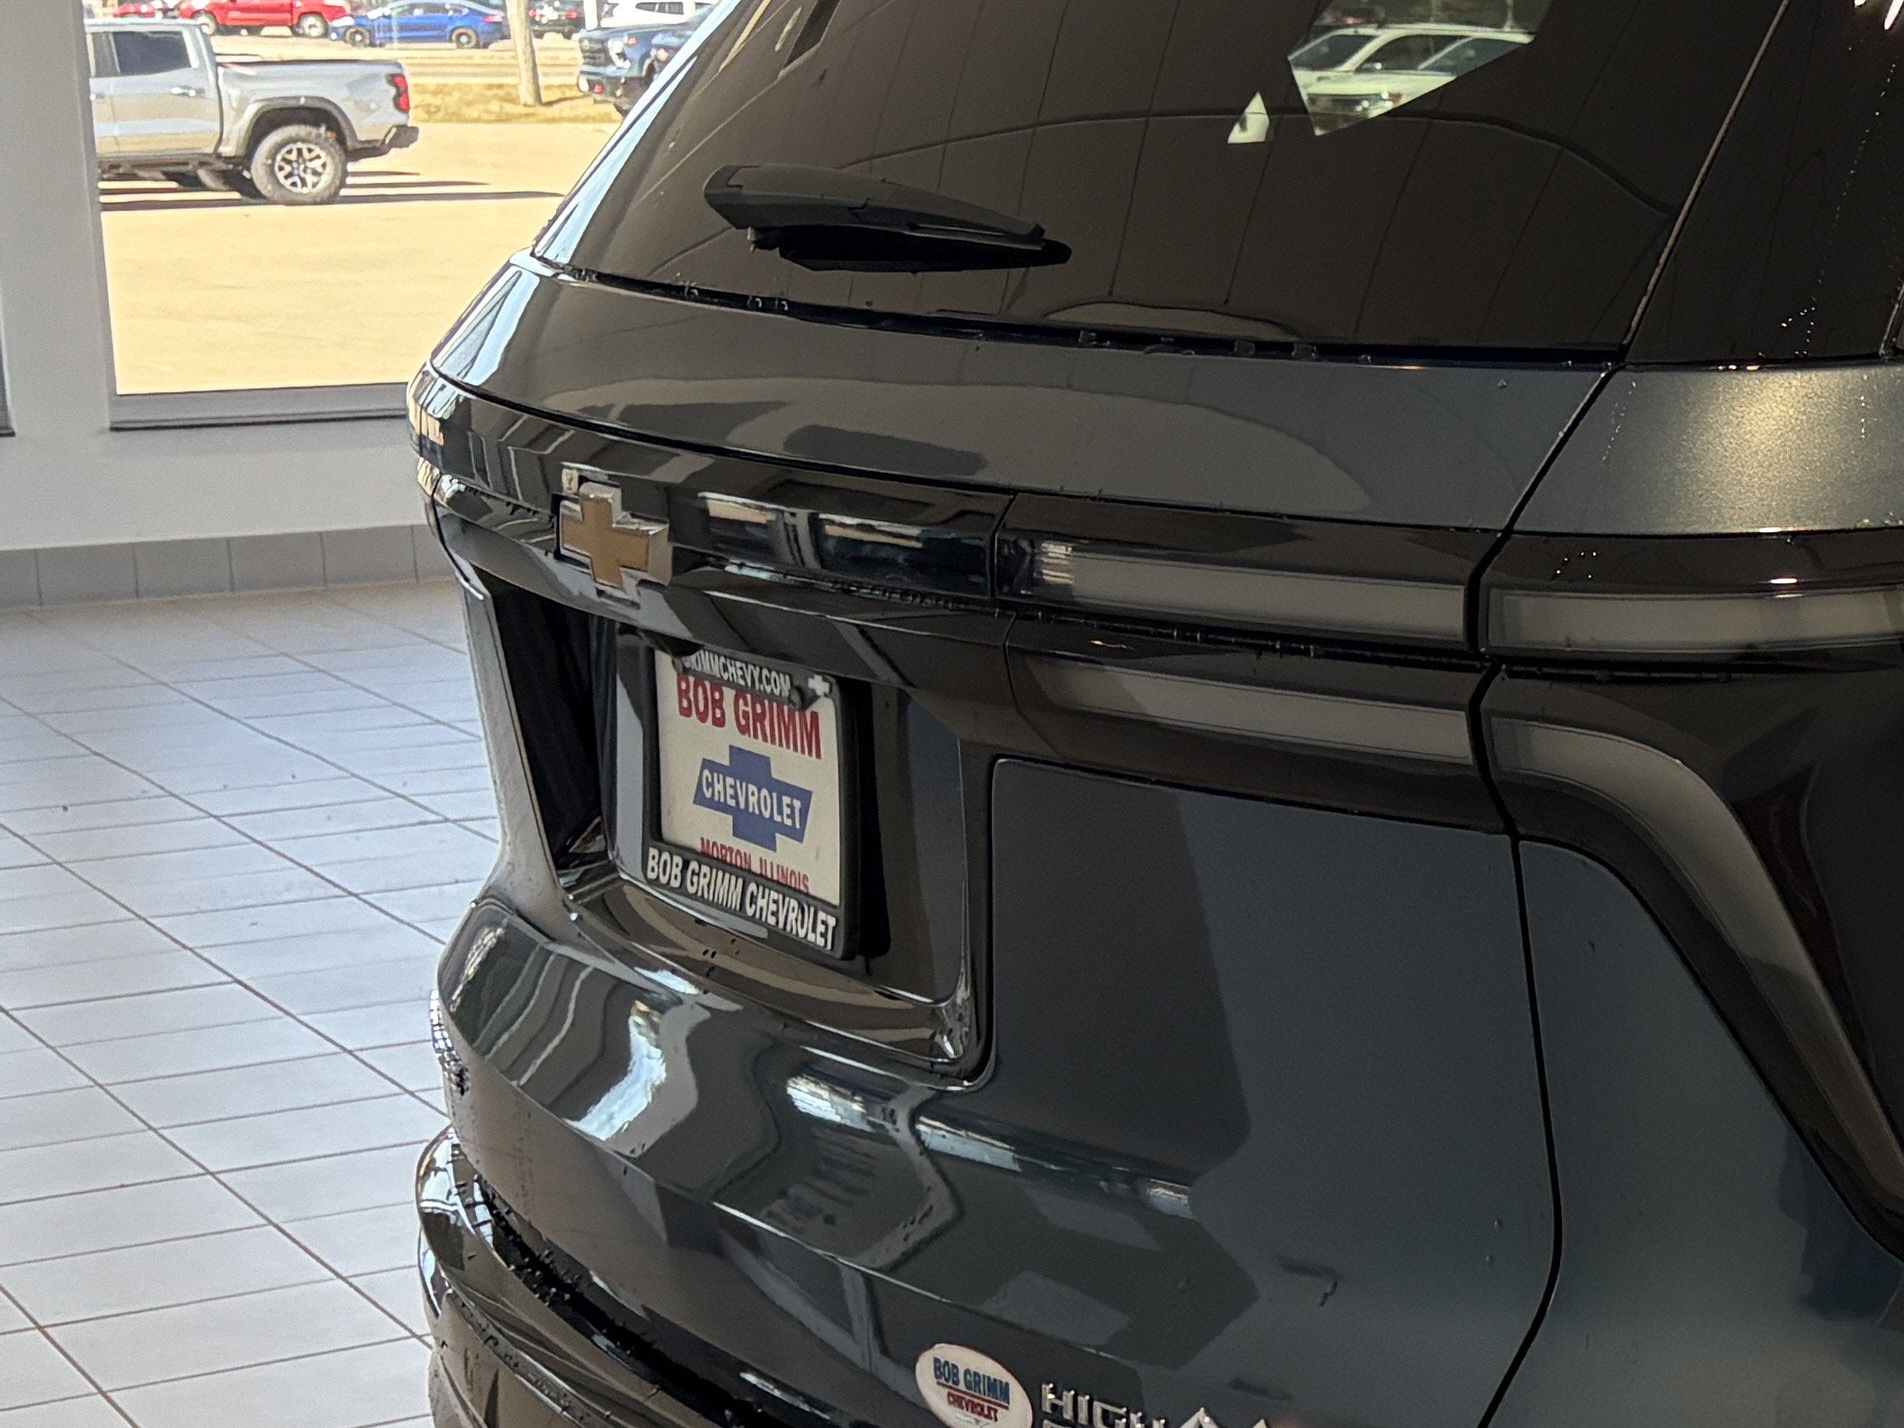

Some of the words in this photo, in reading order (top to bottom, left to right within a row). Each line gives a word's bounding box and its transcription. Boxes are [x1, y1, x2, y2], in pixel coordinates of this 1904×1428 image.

[676, 673, 727, 729] BOB
[733, 689, 823, 760] GRIMM
[701, 768, 803, 831] CHEVROLET
[646, 846, 684, 889] BOB
[686, 860, 744, 912] GRIMM
[744, 881, 837, 952] CHEVROLET
[932, 1356, 961, 1387] BOB
[962, 1367, 1011, 1406] GRIMM
[946, 1390, 999, 1423] CHEVROLET
